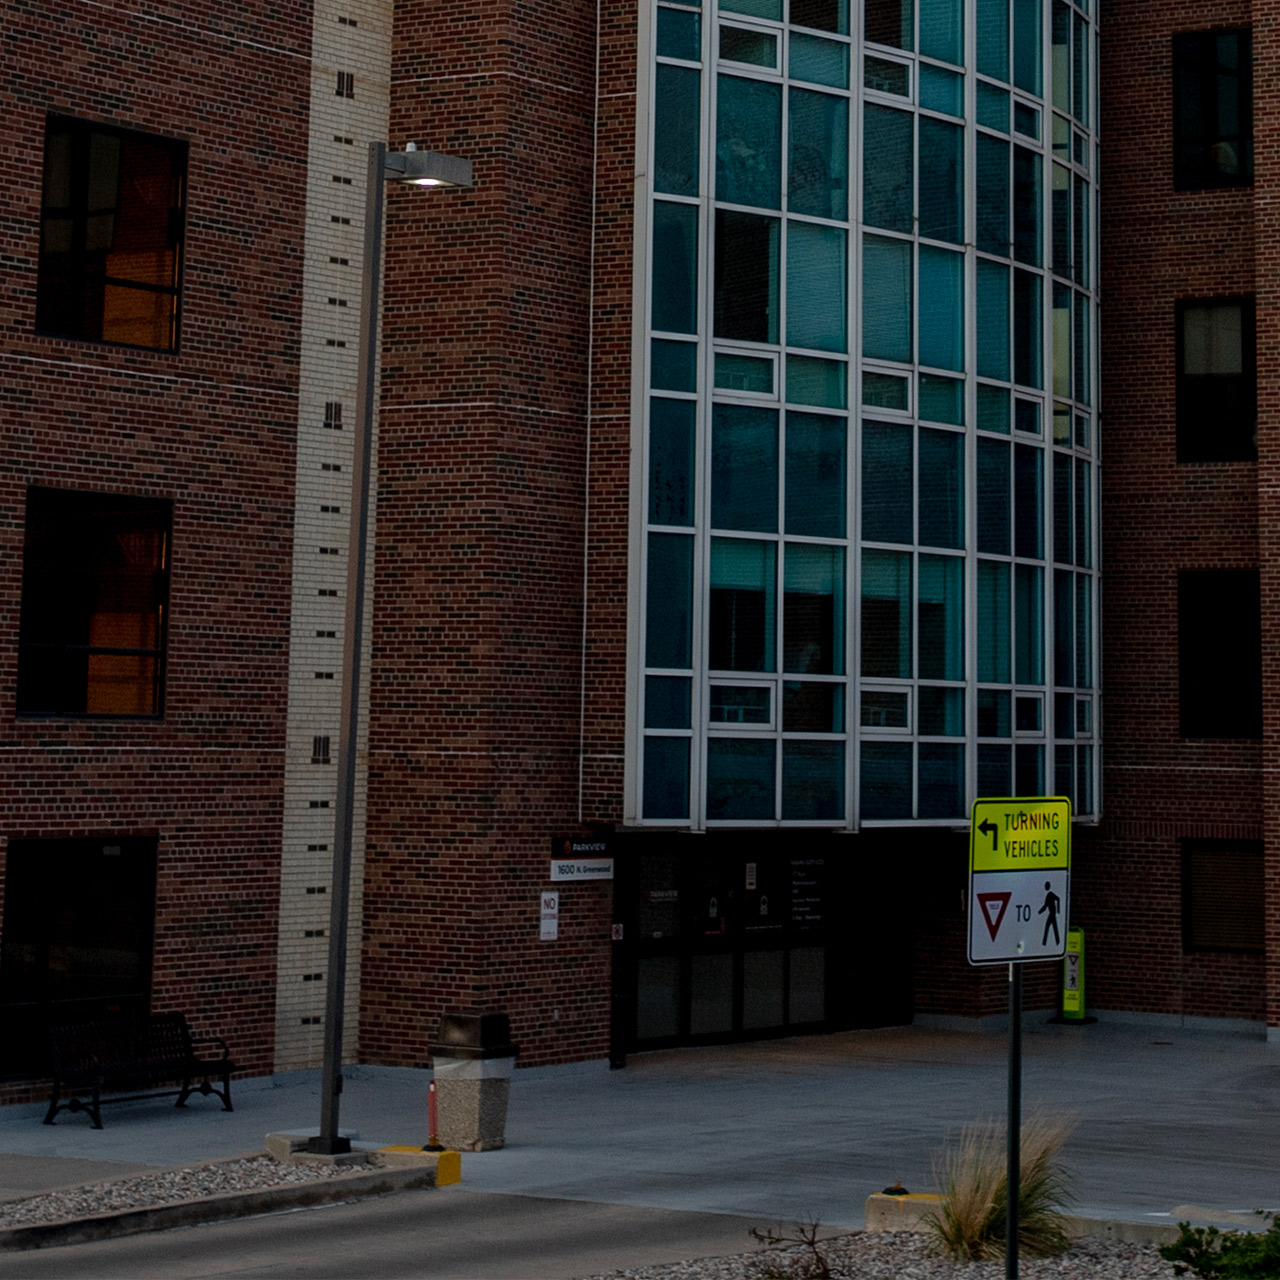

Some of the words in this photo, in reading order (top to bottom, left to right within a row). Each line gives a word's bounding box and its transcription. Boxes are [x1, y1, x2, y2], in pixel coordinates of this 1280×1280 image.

[1004, 812, 1060, 831] TURNING
[572, 842, 607, 852] PARKVIEW
[1004, 839, 1060, 858] VEHICLES
[557, 864, 575, 875] 1600
[583, 865, 611, 873] Greenwood
[543, 898, 556, 910] NO
[1015, 904, 1032, 922] TO
